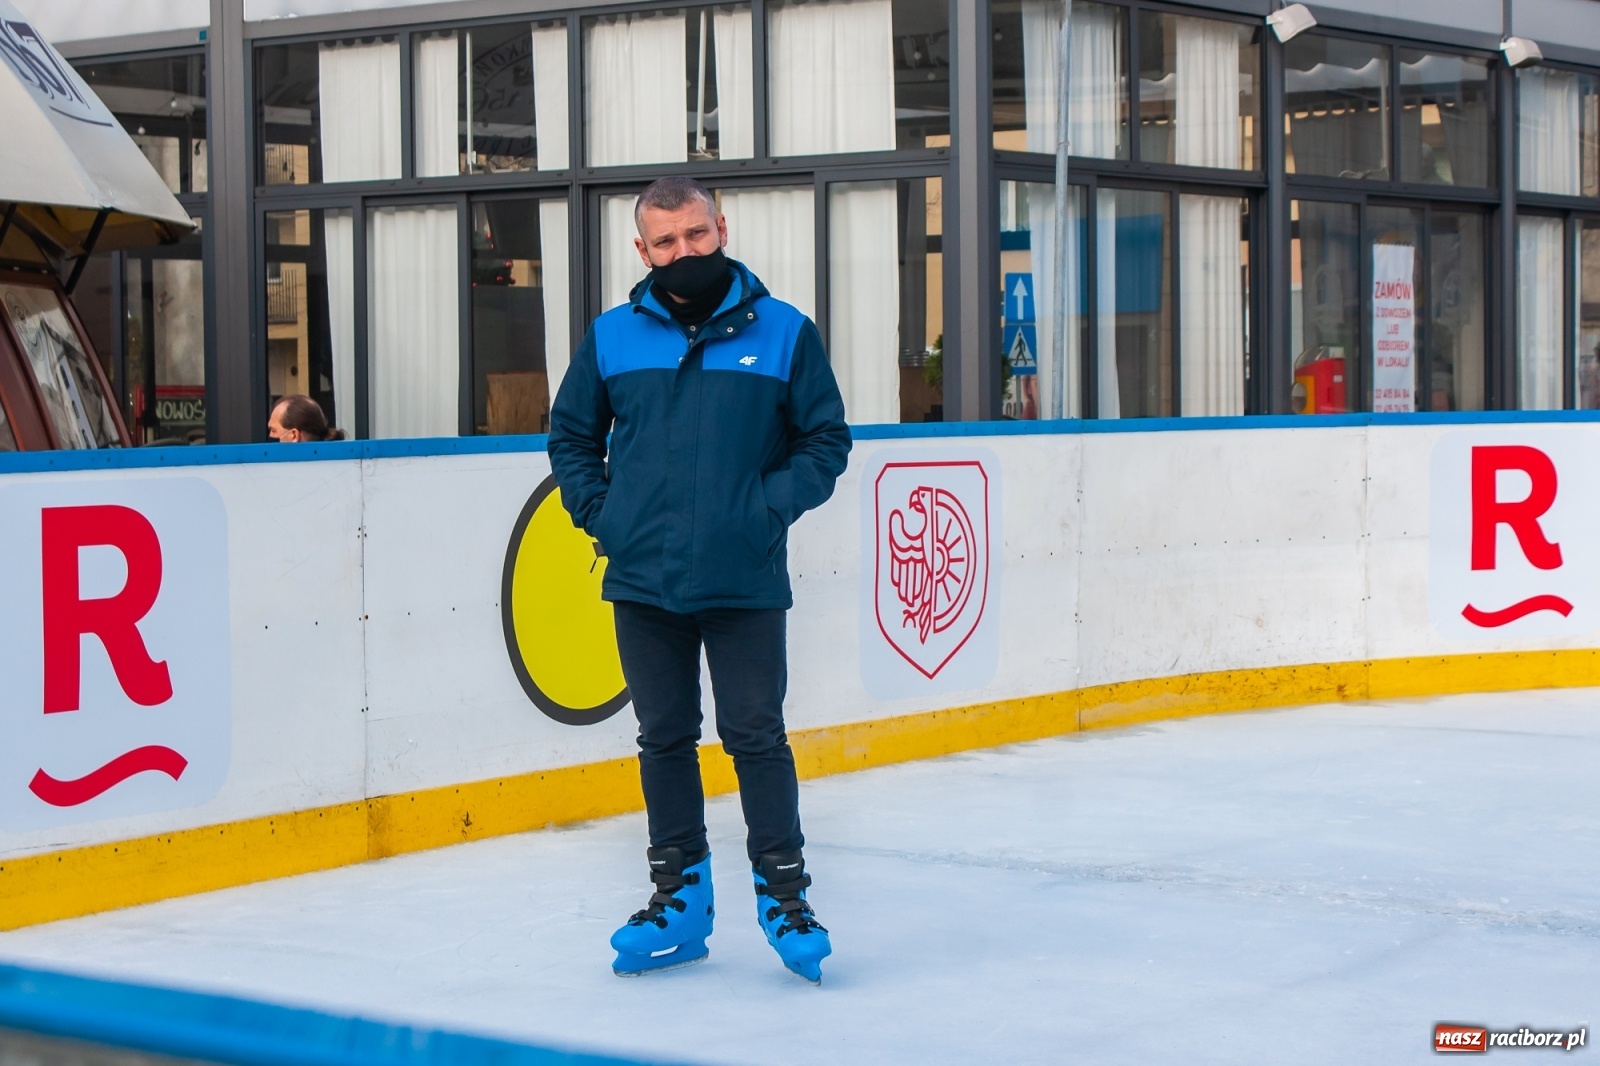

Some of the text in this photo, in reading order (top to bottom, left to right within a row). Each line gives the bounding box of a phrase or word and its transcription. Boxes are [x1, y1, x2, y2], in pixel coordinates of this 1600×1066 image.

[1374, 278, 1411, 300] ZAMÓW
[738, 355, 758, 366] 4F
[1471, 445, 1563, 571] R
[41, 504, 173, 714] R
